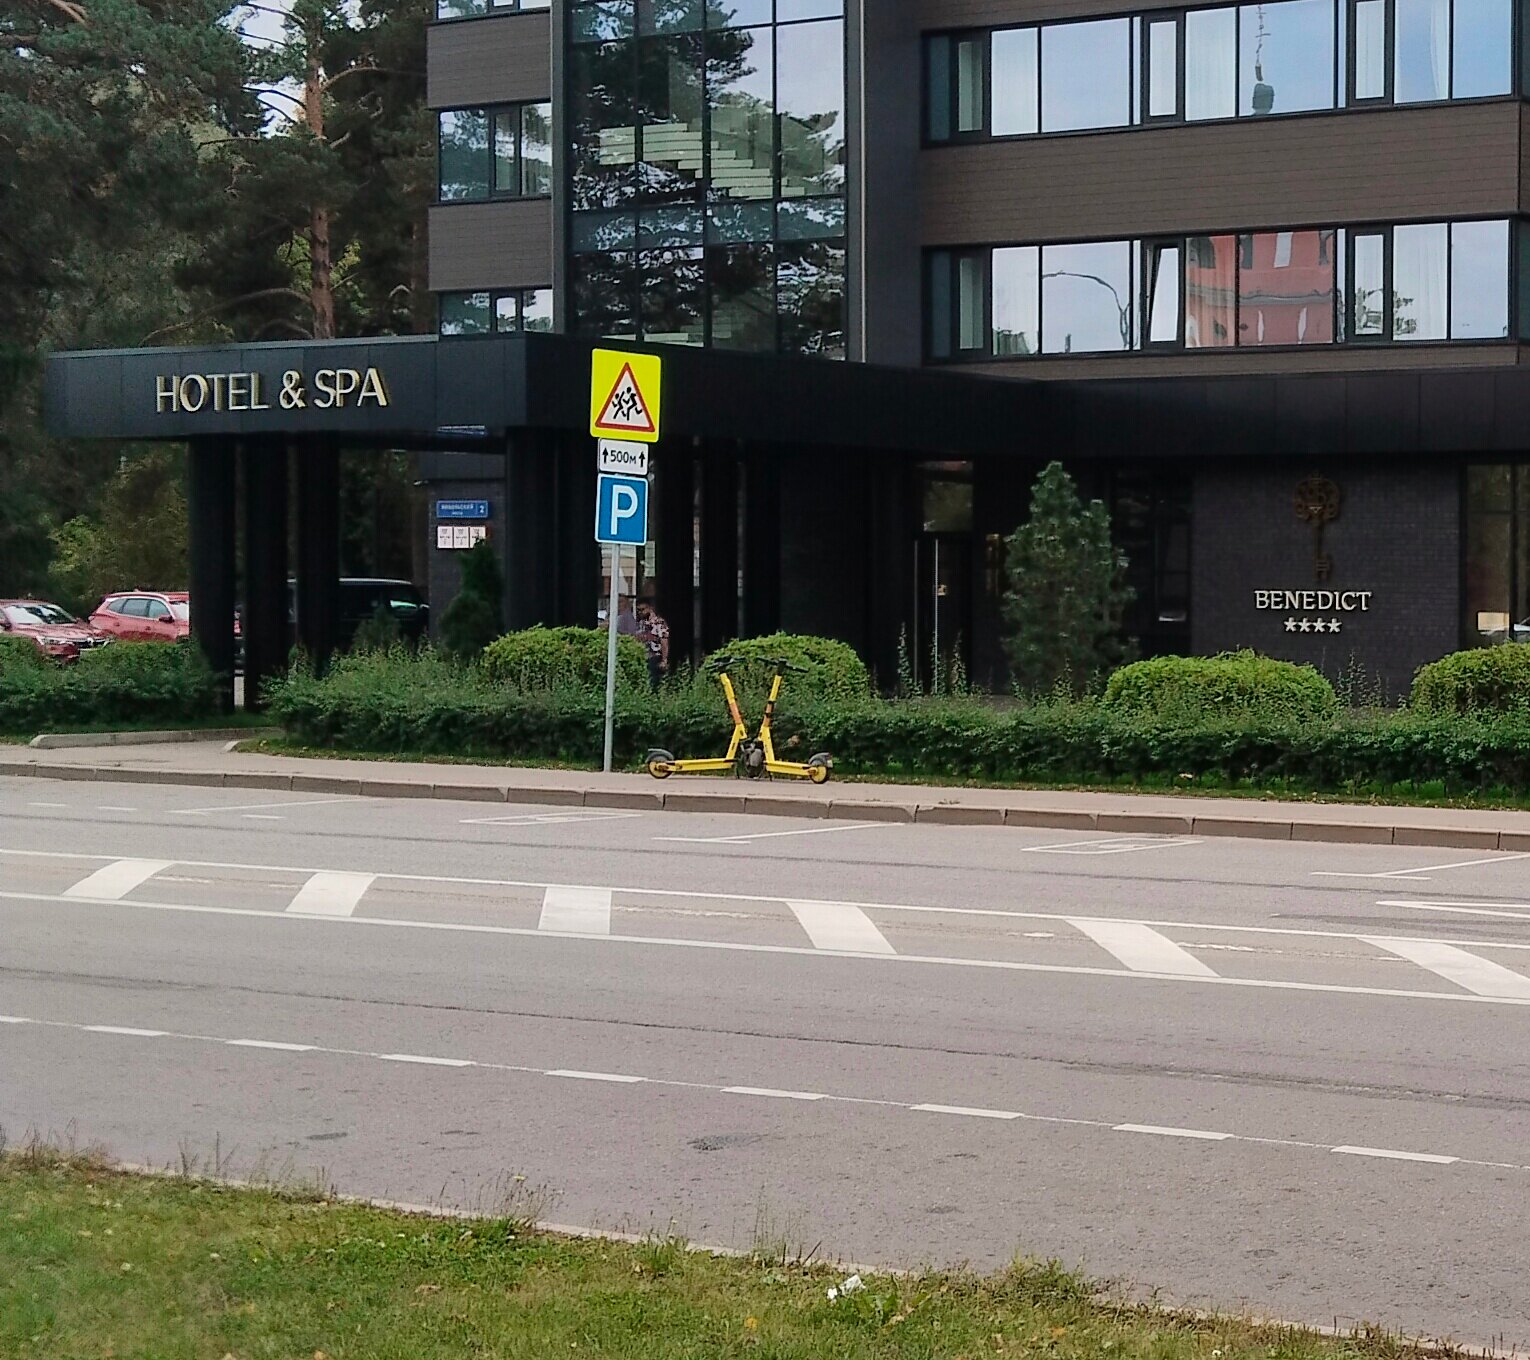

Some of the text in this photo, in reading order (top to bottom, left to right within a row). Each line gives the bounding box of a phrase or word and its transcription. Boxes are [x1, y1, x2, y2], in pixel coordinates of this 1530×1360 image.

[155, 367, 390, 413] HOTEL & SPA
[610, 484, 639, 536] P
[1253, 589, 1373, 611] BENEDICT
